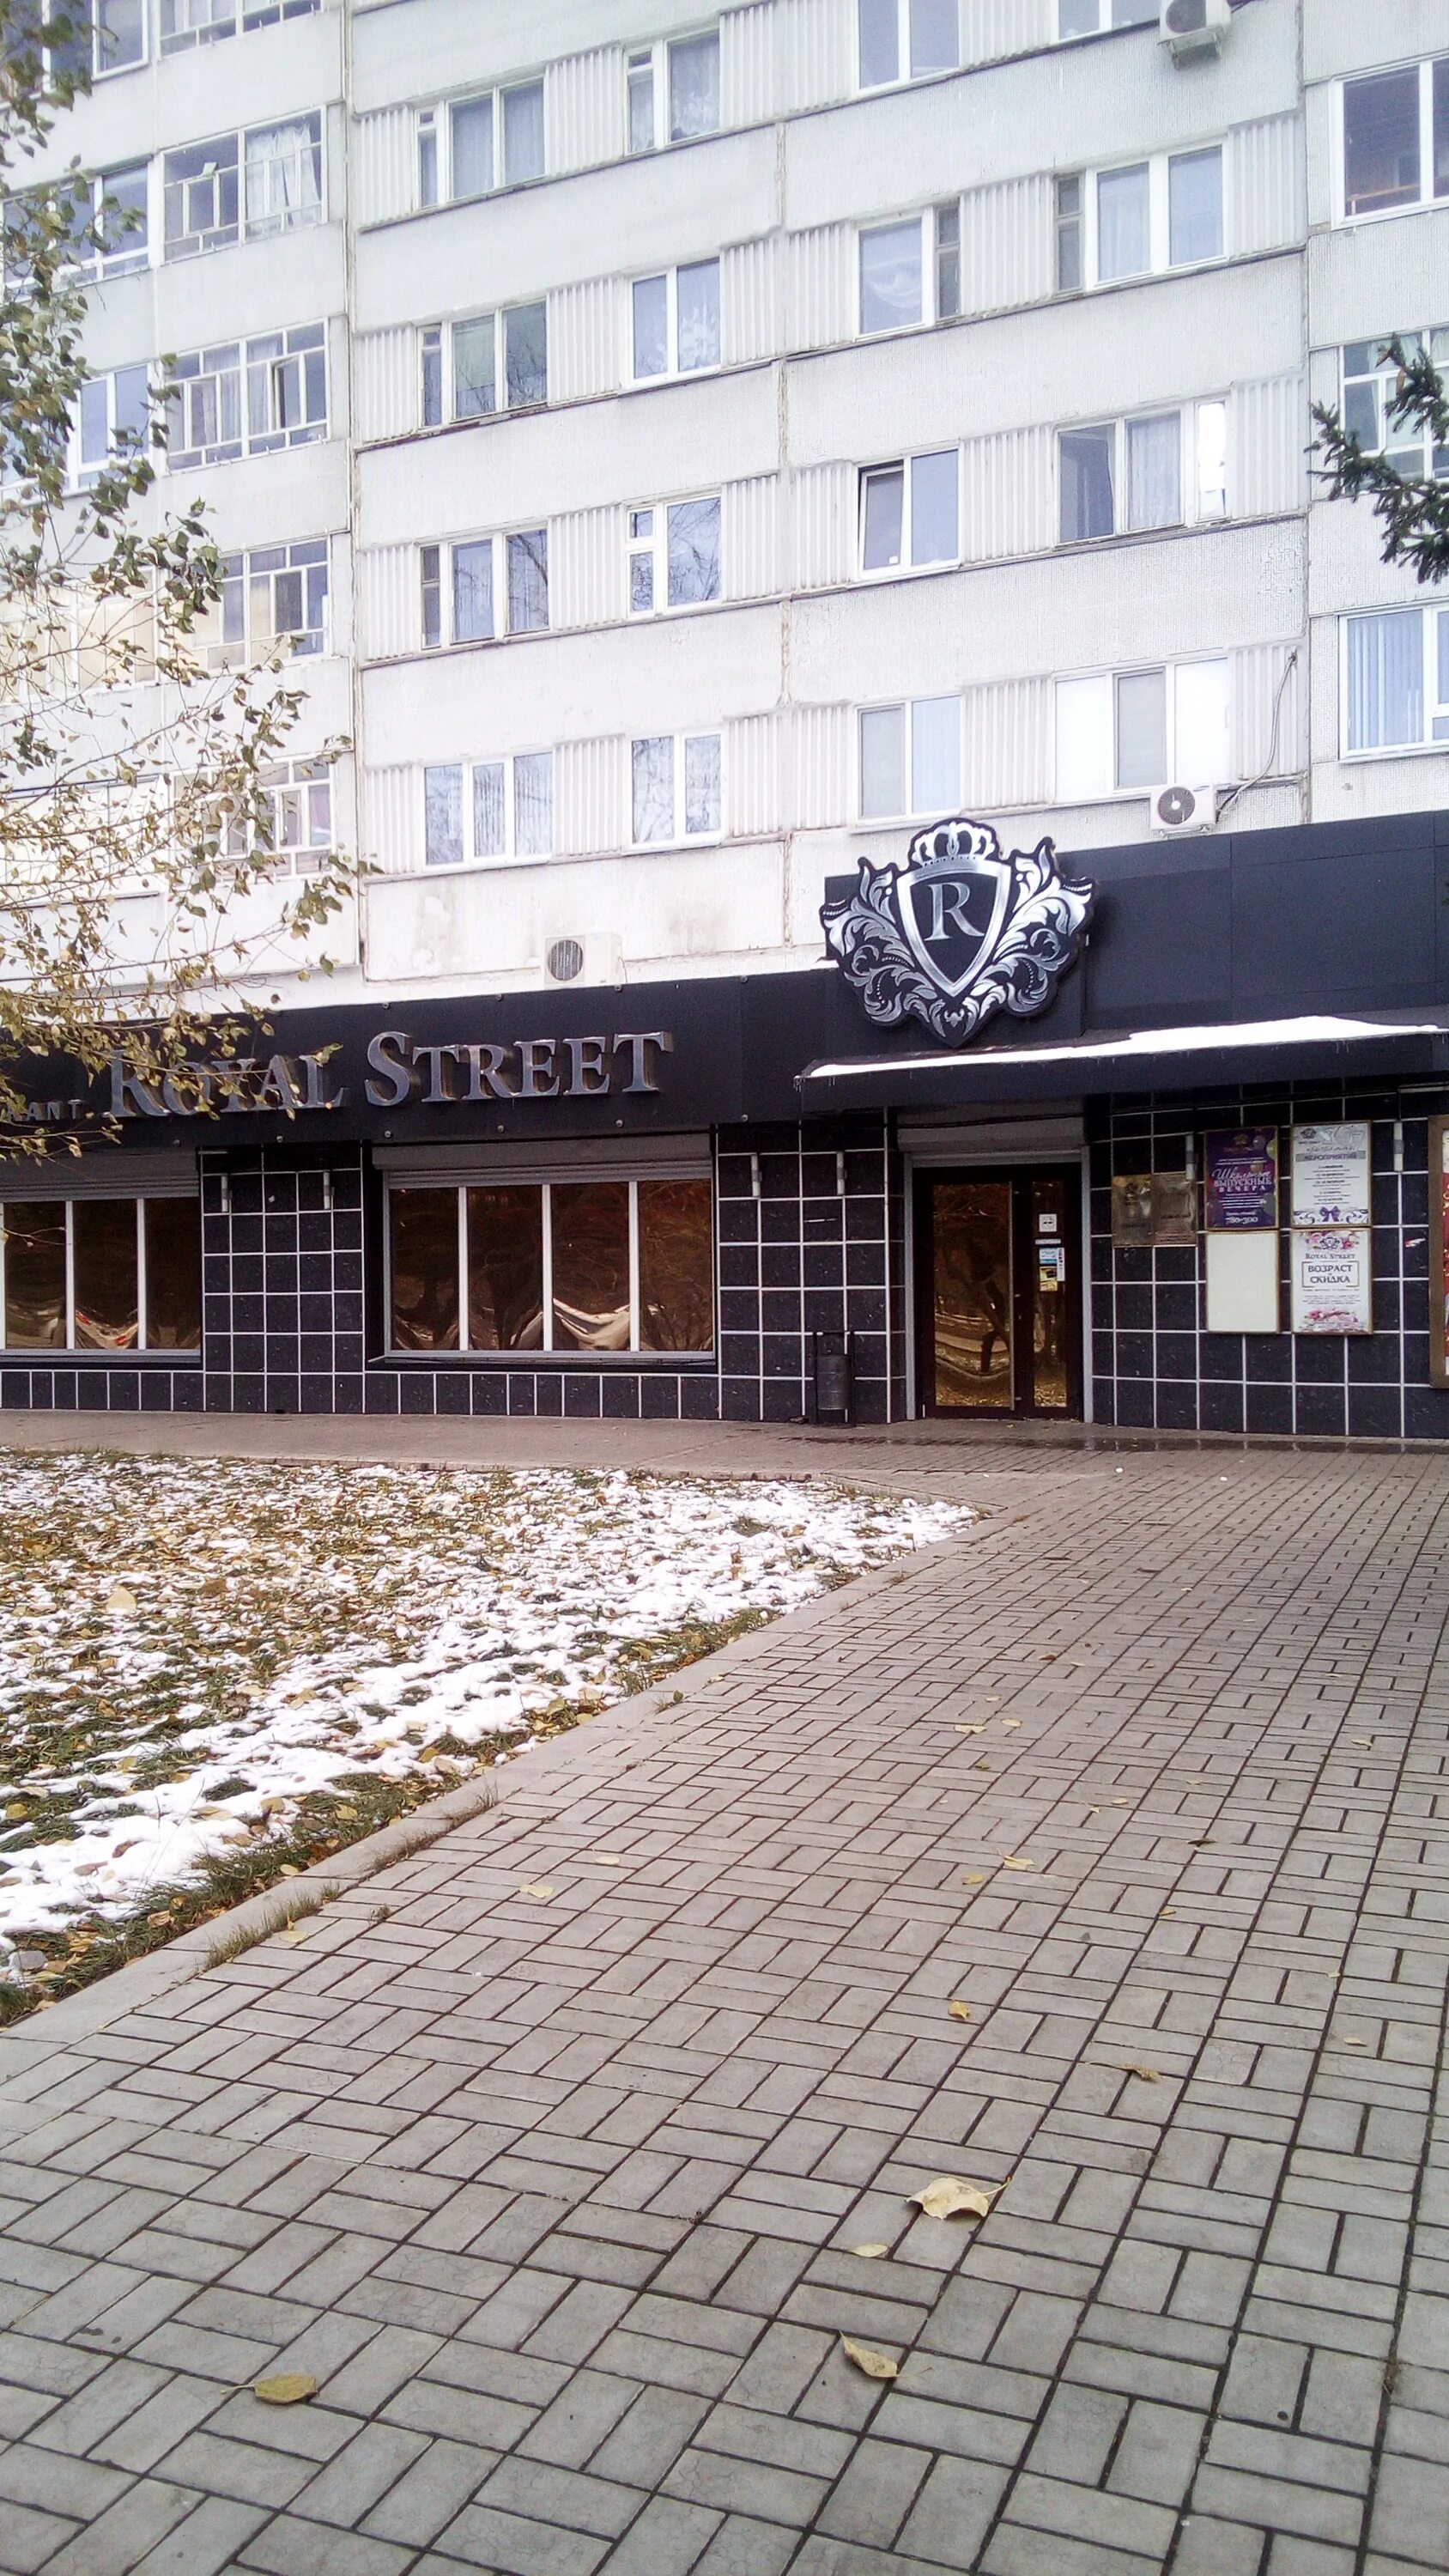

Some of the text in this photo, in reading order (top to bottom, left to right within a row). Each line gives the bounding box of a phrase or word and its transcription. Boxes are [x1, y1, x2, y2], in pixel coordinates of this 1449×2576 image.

[925, 881, 985, 941] R
[365, 1030, 673, 1107] STREET
[1214, 1176, 1272, 1187] ВЫПУСКНЫЕ
[1308, 1264, 1353, 1273] ВОЗРАСТ
